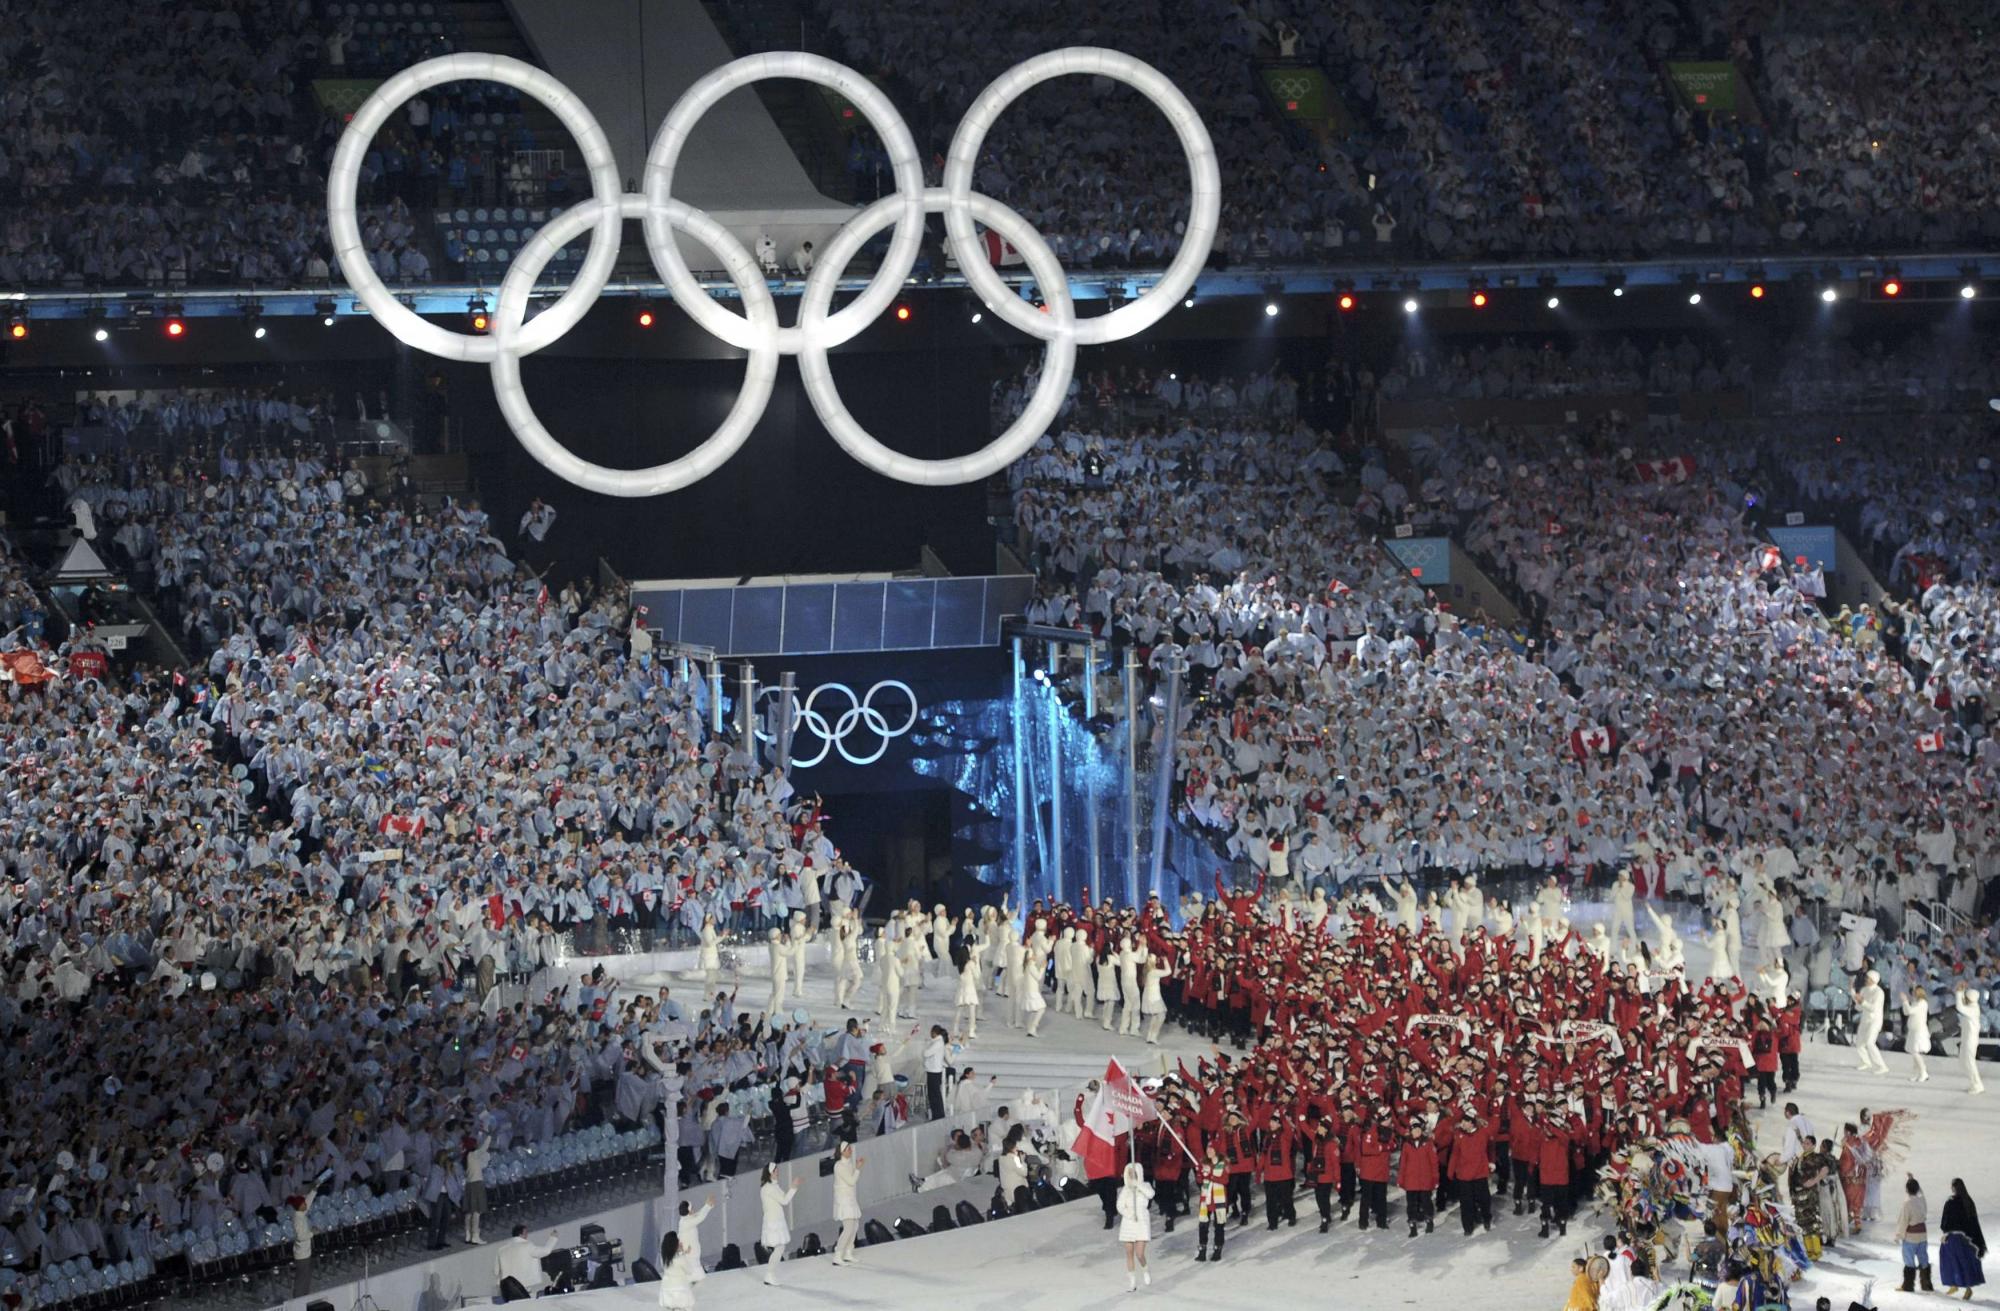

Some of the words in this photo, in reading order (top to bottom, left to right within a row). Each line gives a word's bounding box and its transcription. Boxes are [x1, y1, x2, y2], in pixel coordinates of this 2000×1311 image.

[1702, 1036, 1740, 1047] CANADA
[1111, 1089, 1144, 1107] CANADA
[1111, 1099, 1145, 1116] CANADA
